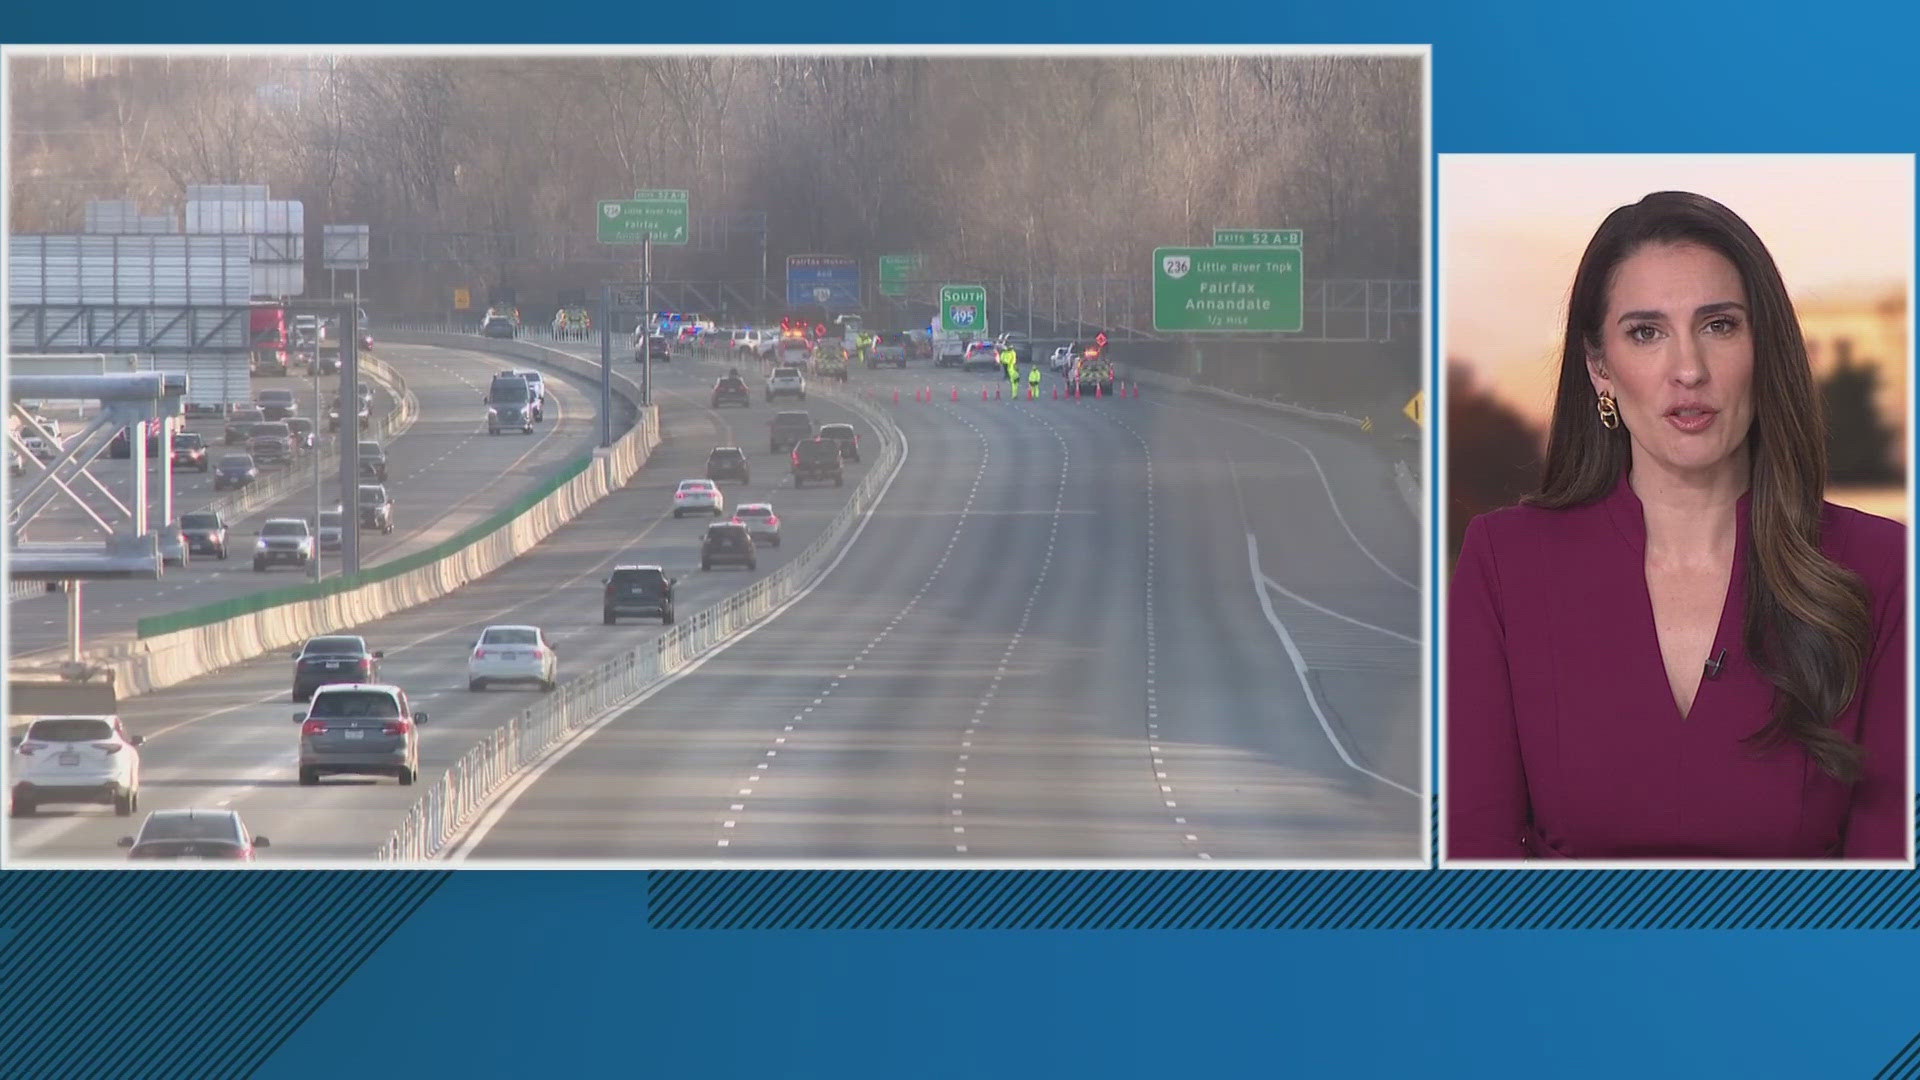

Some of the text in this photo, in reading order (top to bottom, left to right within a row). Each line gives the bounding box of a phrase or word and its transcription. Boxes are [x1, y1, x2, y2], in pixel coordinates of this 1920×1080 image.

[625, 221, 659, 229] Fairfax
[1218, 233, 1298, 244] EXITS 52 A-B
[1167, 261, 1188, 274] 236
[1197, 262, 1292, 275] Little River Tnpk
[1200, 282, 1255, 294] Fairfax
[944, 290, 983, 302] SOUTH
[1185, 298, 1271, 310] Annandale
[953, 311, 974, 323] 495
